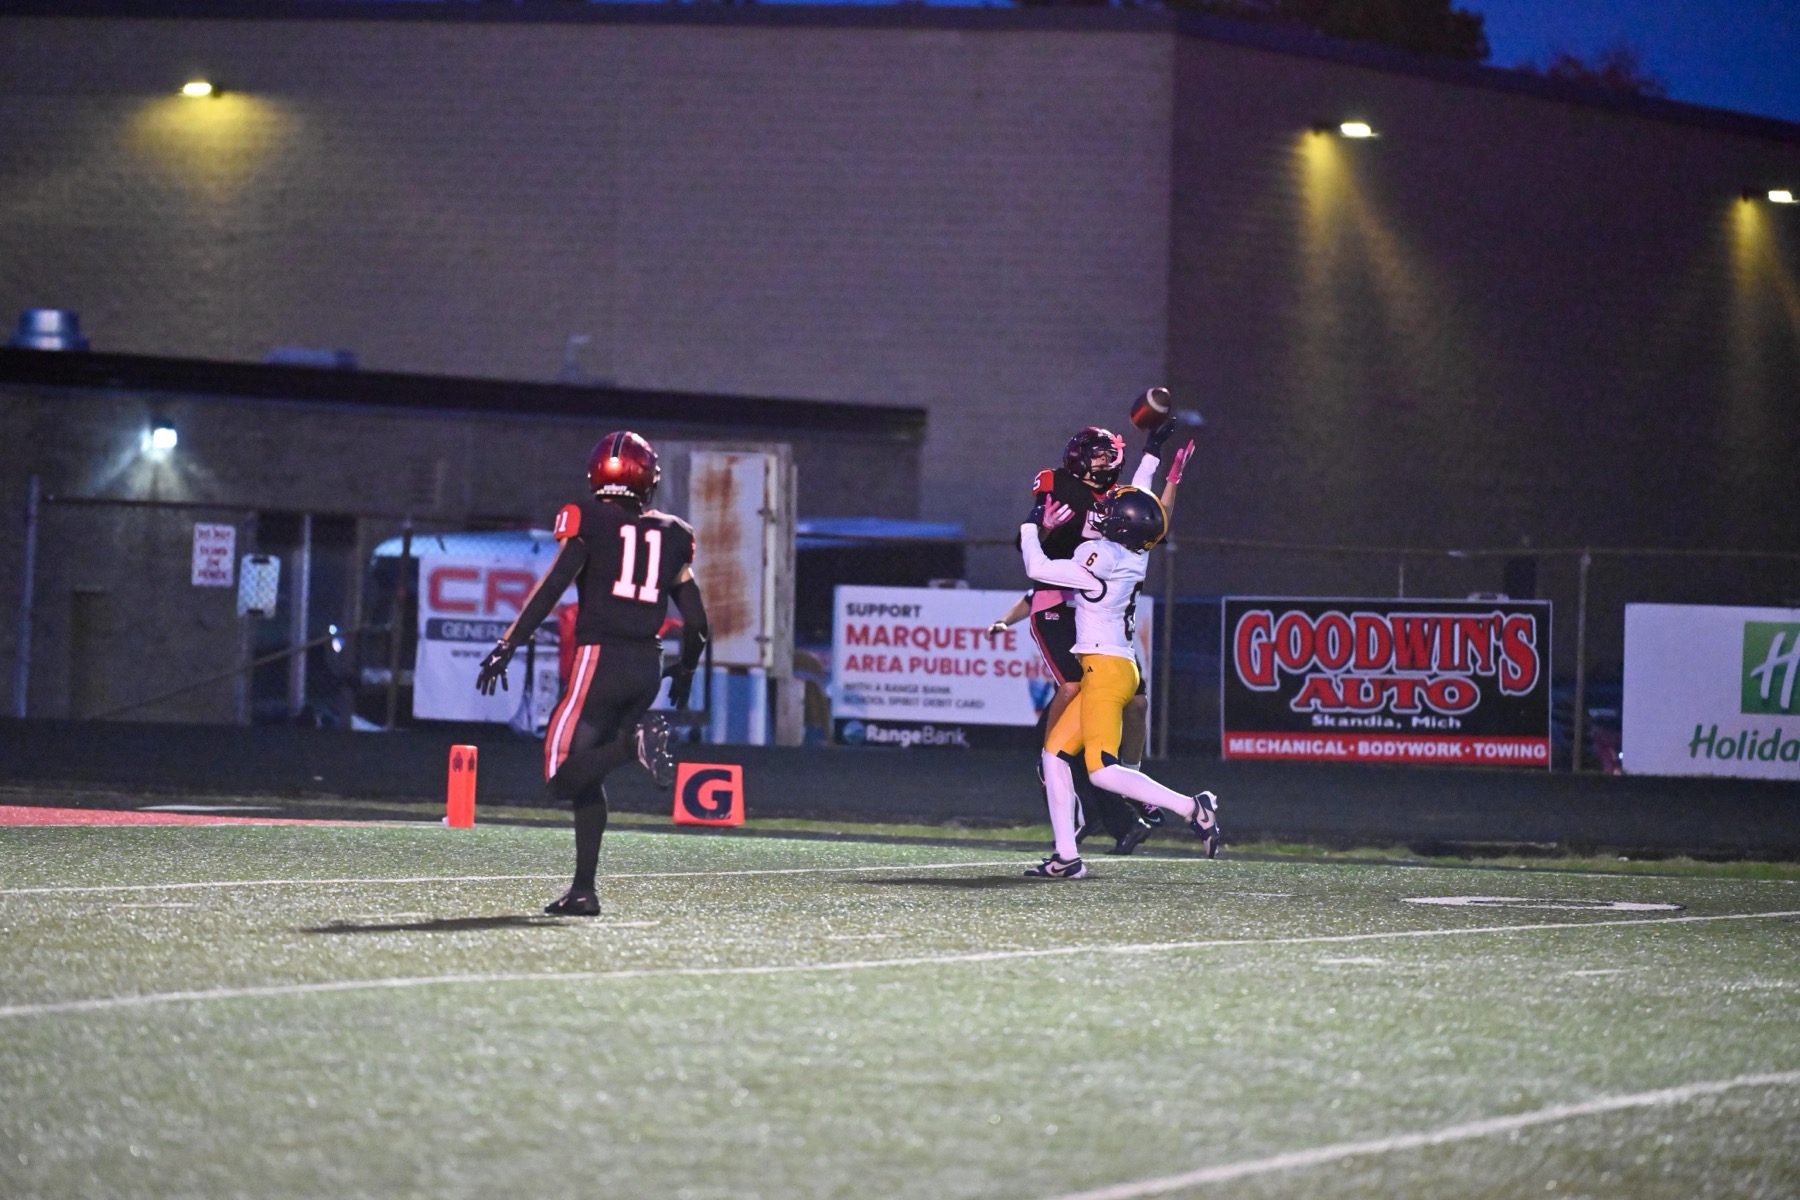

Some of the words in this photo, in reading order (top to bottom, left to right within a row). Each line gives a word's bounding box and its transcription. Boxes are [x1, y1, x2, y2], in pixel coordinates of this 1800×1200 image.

[611, 524, 663, 603] 11
[1086, 552, 1098, 567] 6
[846, 603, 922, 618] SUPPORT
[845, 624, 1017, 651] MARQUETTE
[1234, 610, 1540, 695] GOODWIN'S
[845, 654, 903, 673] AREA
[909, 657, 987, 676] PUBLIC
[1290, 674, 1481, 714] AUTO
[1311, 714, 1402, 730] Skandia,
[1411, 716, 1462, 729] Mich
[1228, 738, 1347, 755] MECHANICAL
[1357, 741, 1463, 757] BODYWORK
[1473, 743, 1546, 758] TOWING
[682, 768, 734, 821] G
